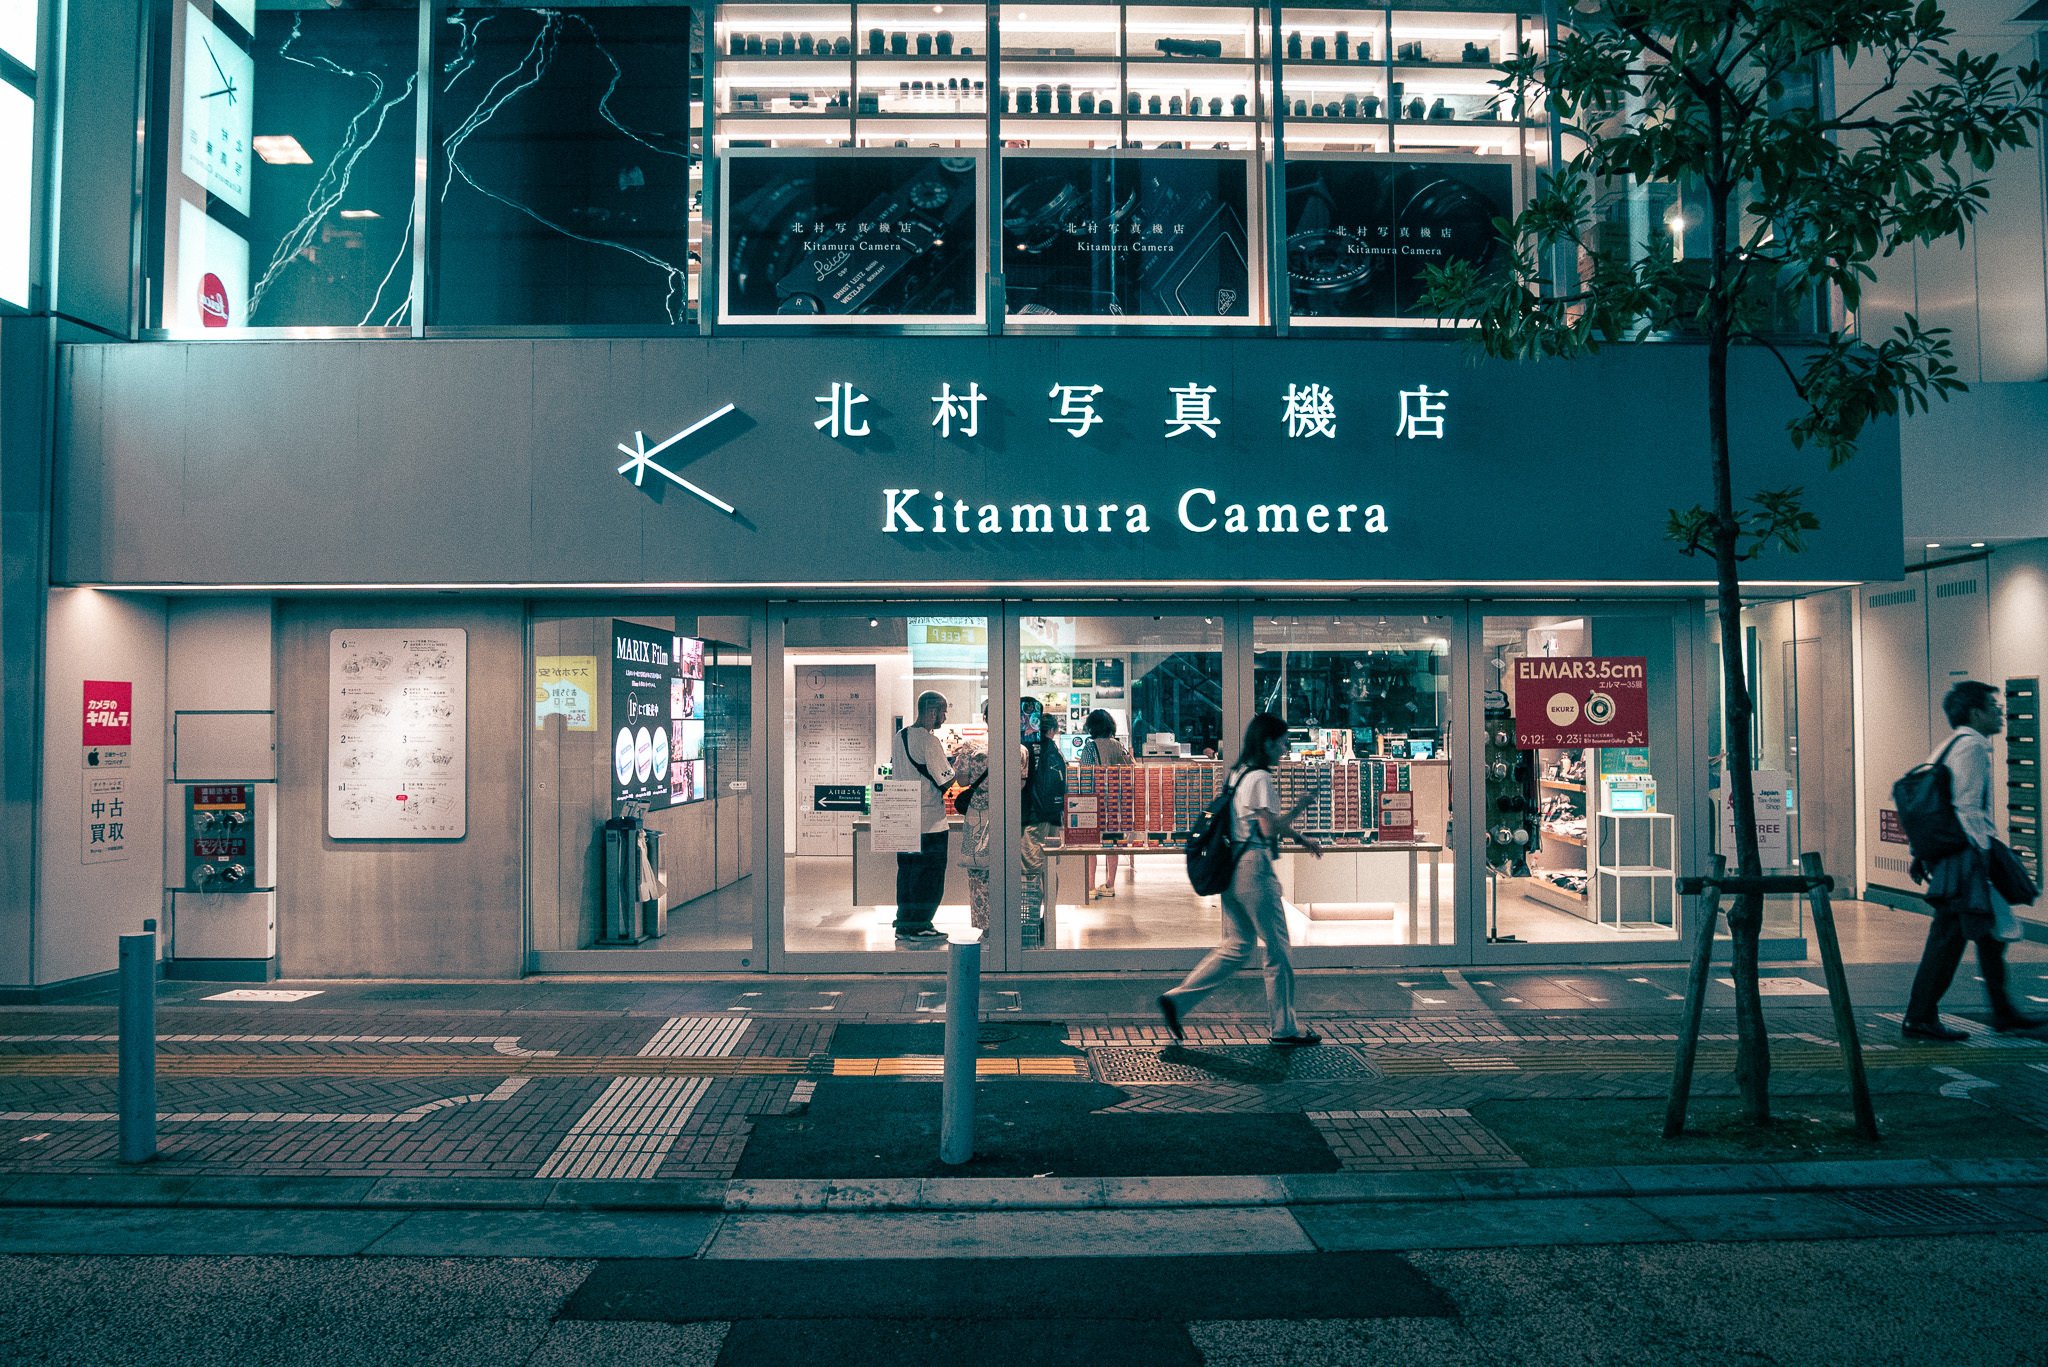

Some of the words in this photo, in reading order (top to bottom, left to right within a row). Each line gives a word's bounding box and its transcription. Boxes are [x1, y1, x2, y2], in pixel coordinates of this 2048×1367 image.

[792, 222, 912, 233] 北村写真機店
[1066, 223, 1185, 234] 北村写真機店
[1336, 225, 1452, 238] 北村写真機店
[803, 241, 855, 251] Kitamura
[859, 241, 901, 251] Camera
[1077, 242, 1128, 252] Kitamura
[1132, 242, 1174, 252] Camera
[1347, 244, 1397, 255] Kitamura
[1401, 245, 1442, 255] Camera
[813, 250, 851, 282] Leica
[832, 283, 852, 300] ERNST
[850, 271, 866, 285] LEITZ
[840, 282, 867, 305] WETZLAR
[795, 298, 802, 306] R
[813, 381, 1450, 440] 北村写真機店
[882, 488, 1150, 535] Kitamura
[1177, 486, 1390, 535] Camera
[341, 640, 348, 649] 6
[402, 640, 409, 649] 7
[616, 636, 650, 663] MARIX
[651, 643, 669, 666] Film
[341, 687, 347, 696] 4
[402, 687, 408, 696] 5
[87, 700, 118, 710] カメラの
[86, 711, 129, 727] キタムラ
[340, 735, 346, 744] 2
[402, 735, 407, 744] 3
[1520, 735, 1541, 745] 9.12
[1556, 734, 1579, 744] 9.23
[91, 797, 124, 819] 中古
[90, 822, 124, 844] 買取
